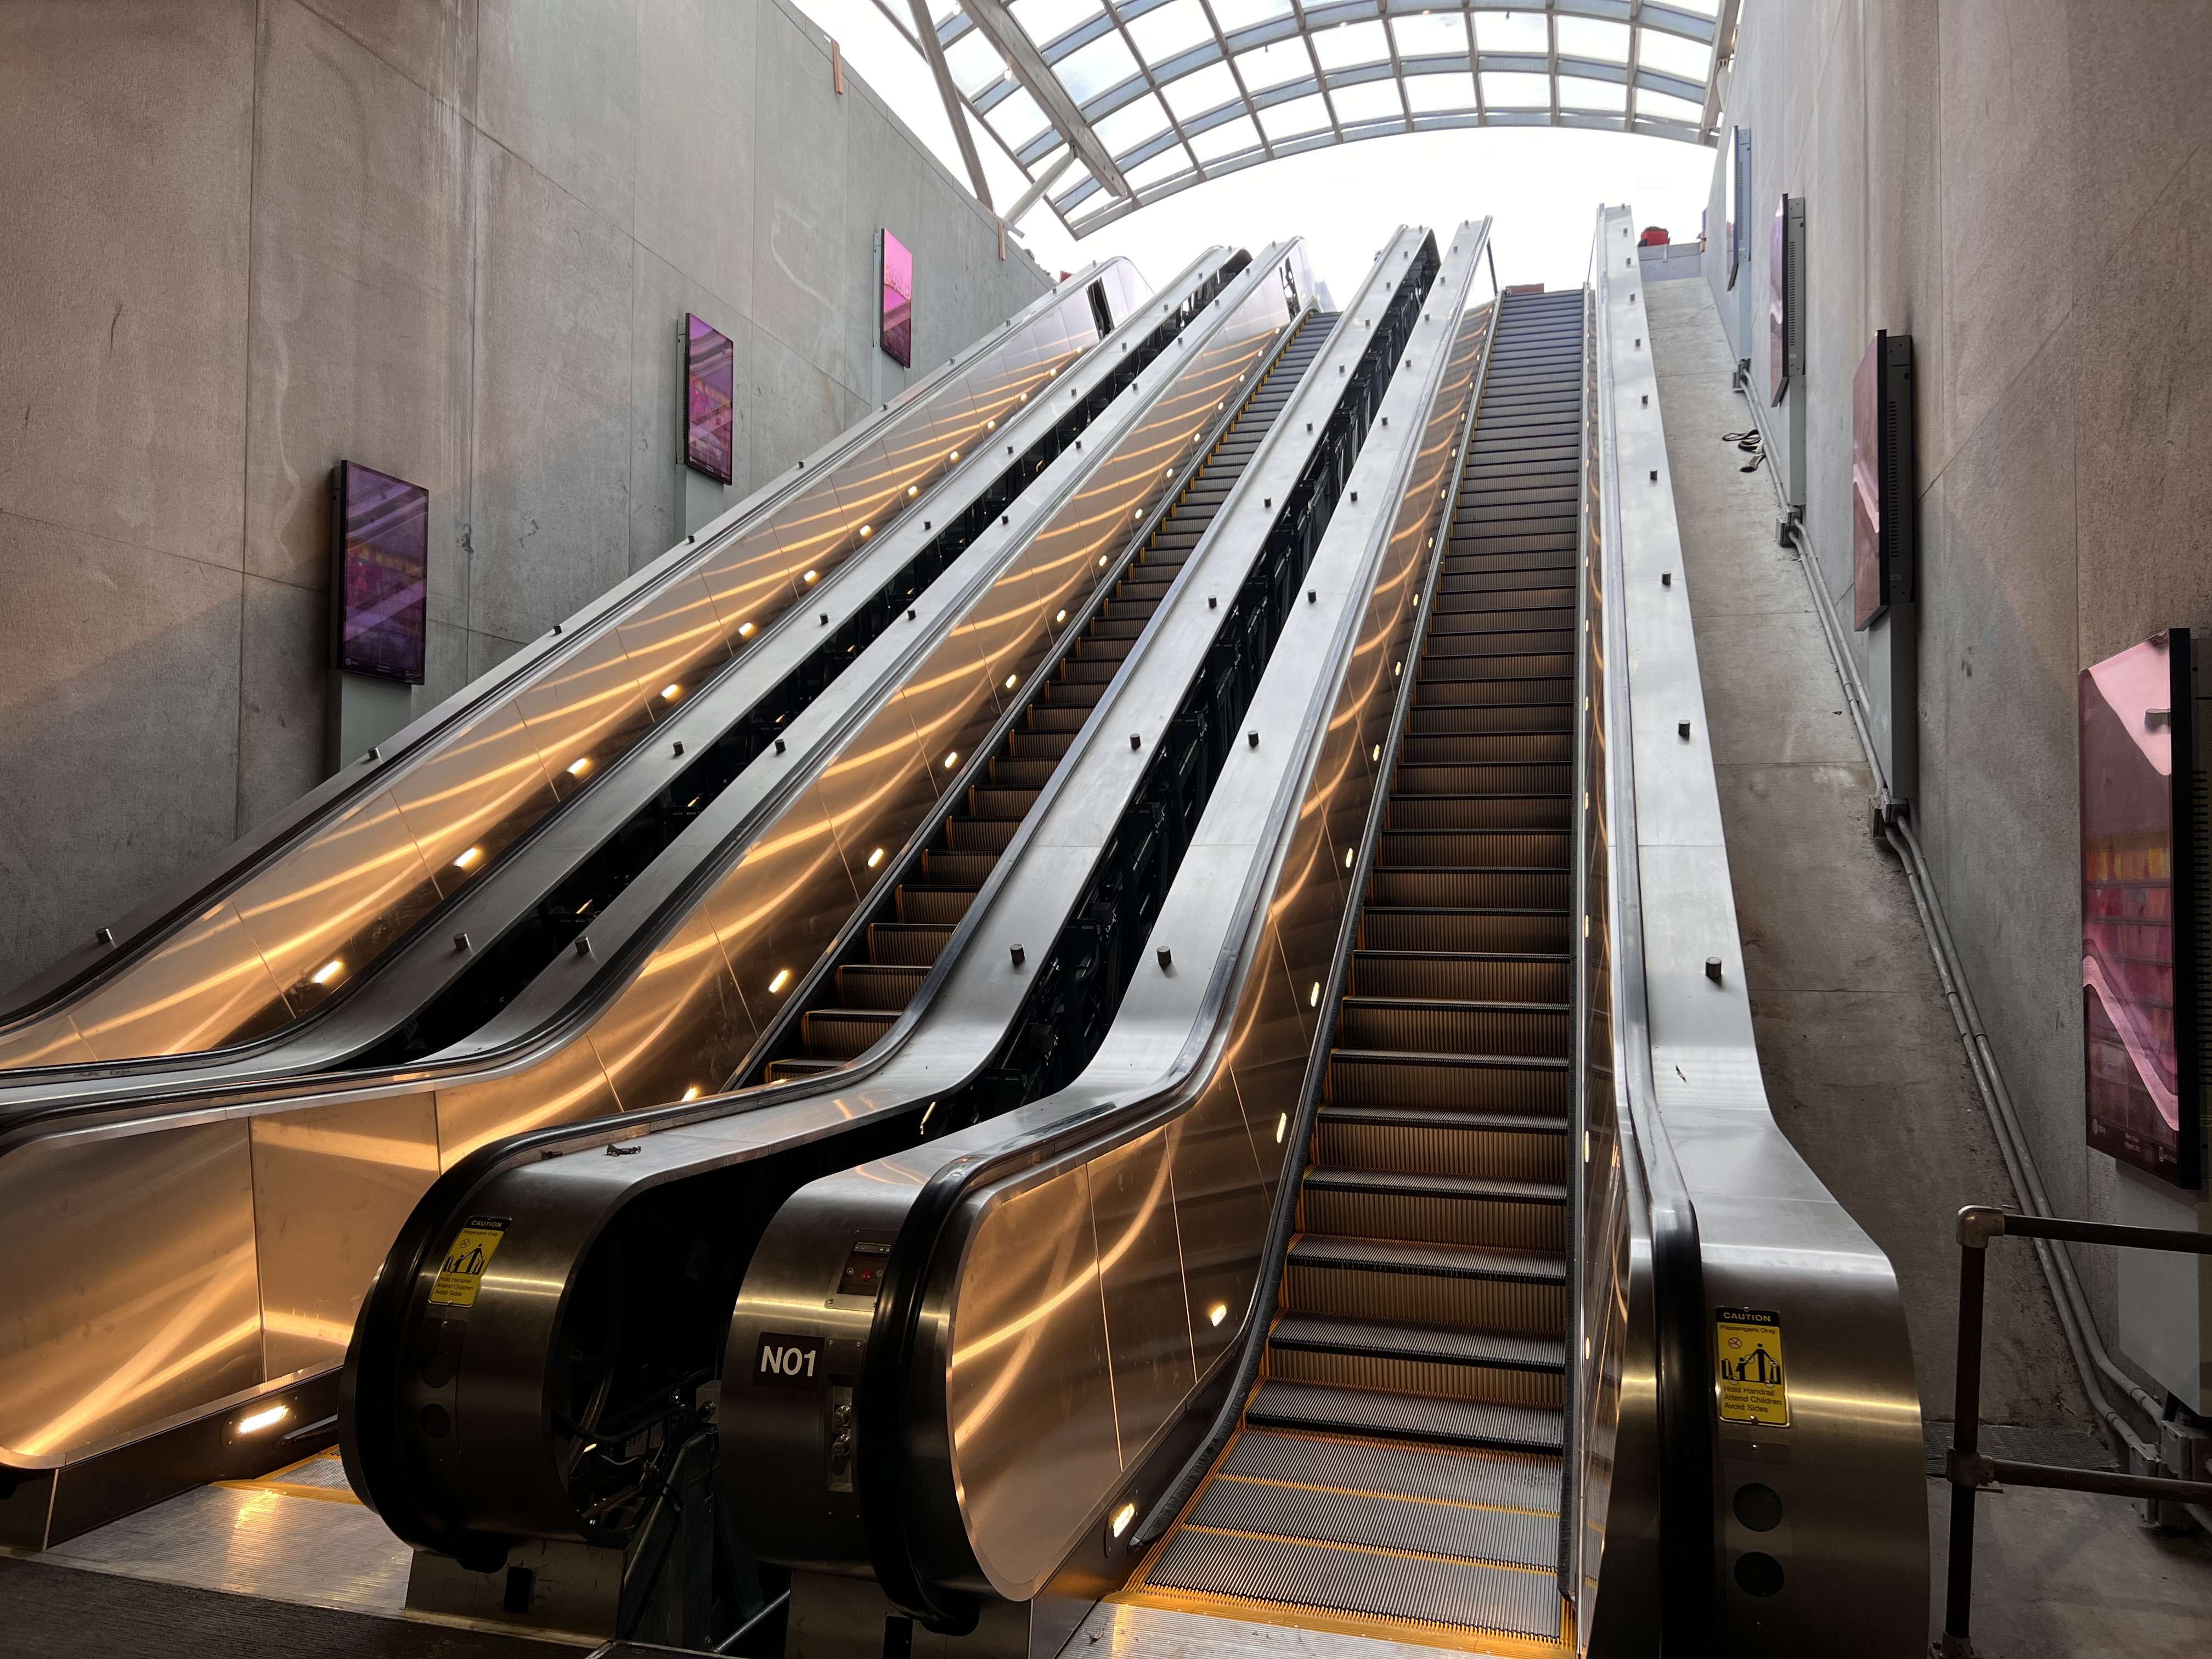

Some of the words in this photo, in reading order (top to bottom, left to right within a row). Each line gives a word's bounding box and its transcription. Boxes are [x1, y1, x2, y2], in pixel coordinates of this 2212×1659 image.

[1723, 1312, 1771, 1322] CAUTION
[1720, 1324, 1759, 1333] Passengers
[1743, 1387, 1775, 1396] Handrail
[1724, 1393, 1748, 1402] Attend
[1750, 1396, 1782, 1406] Children
[1724, 1402, 1745, 1410] Avoid
[1747, 1404, 1768, 1413] Sides
